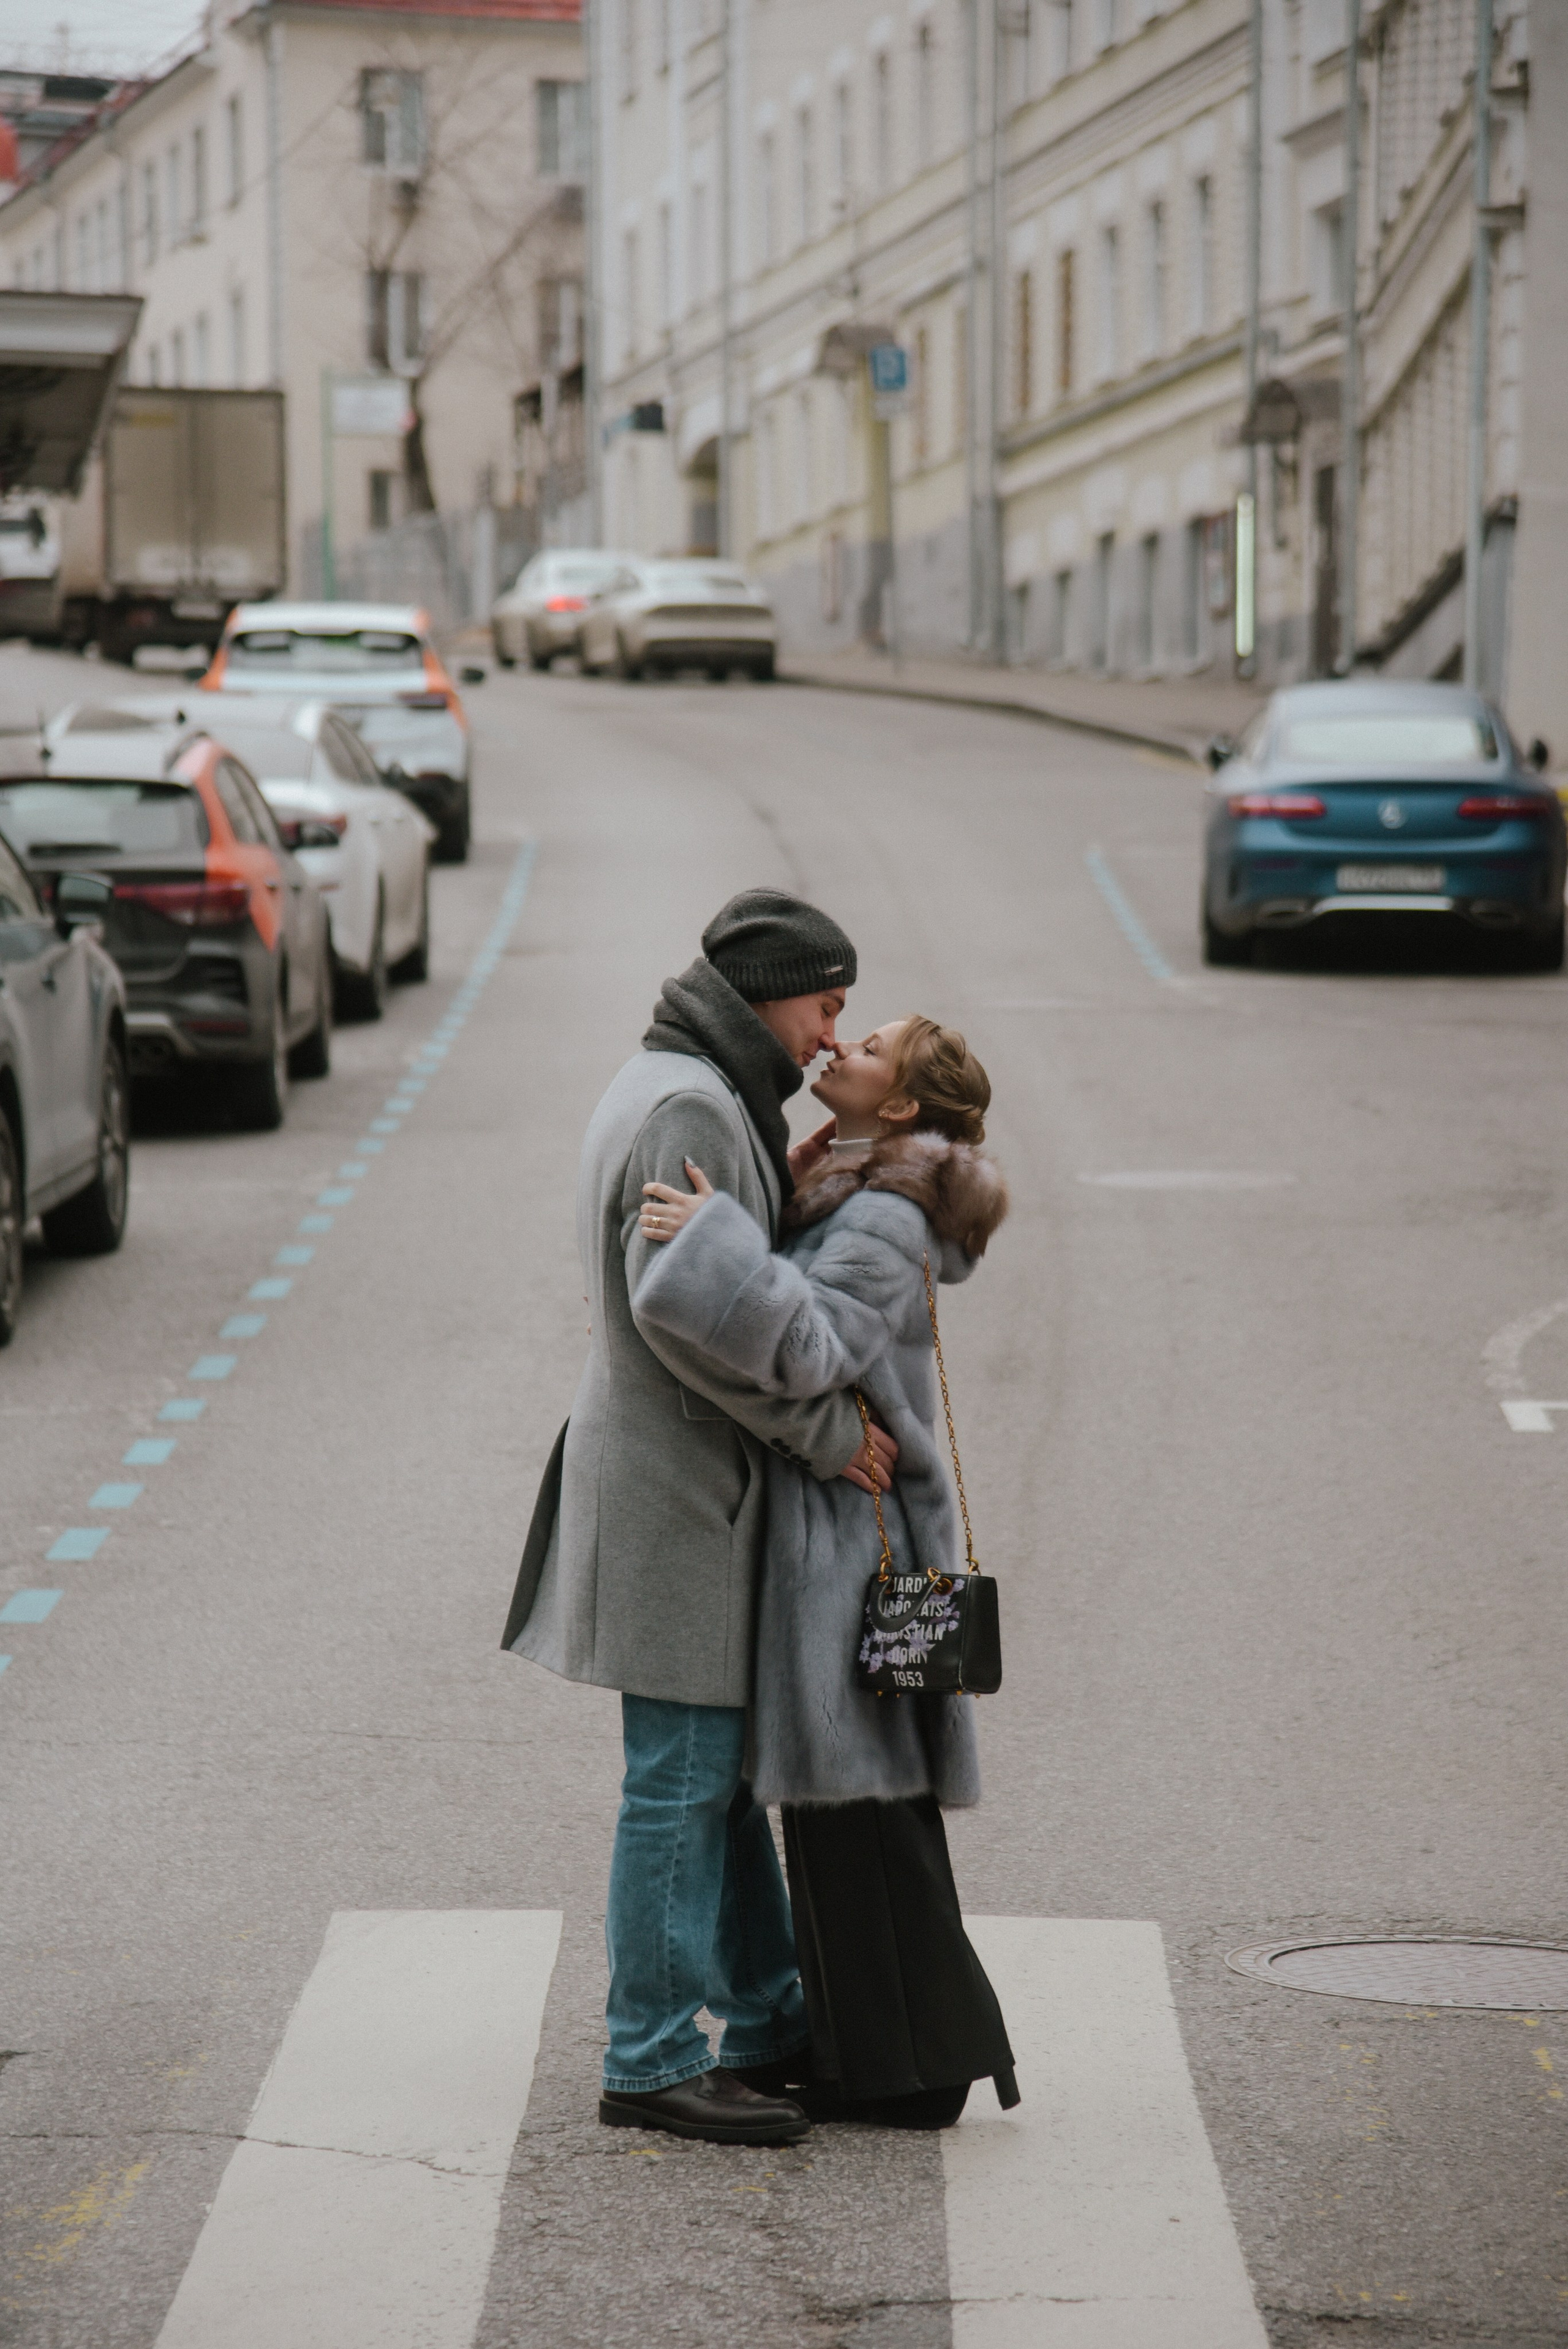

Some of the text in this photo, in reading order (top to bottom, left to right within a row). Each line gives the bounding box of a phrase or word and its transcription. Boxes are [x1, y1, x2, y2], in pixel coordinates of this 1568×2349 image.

[892, 1577, 929, 1593] JARD
[883, 1600, 944, 1617] JAPOAIS
[892, 1671, 924, 1687] 1953
